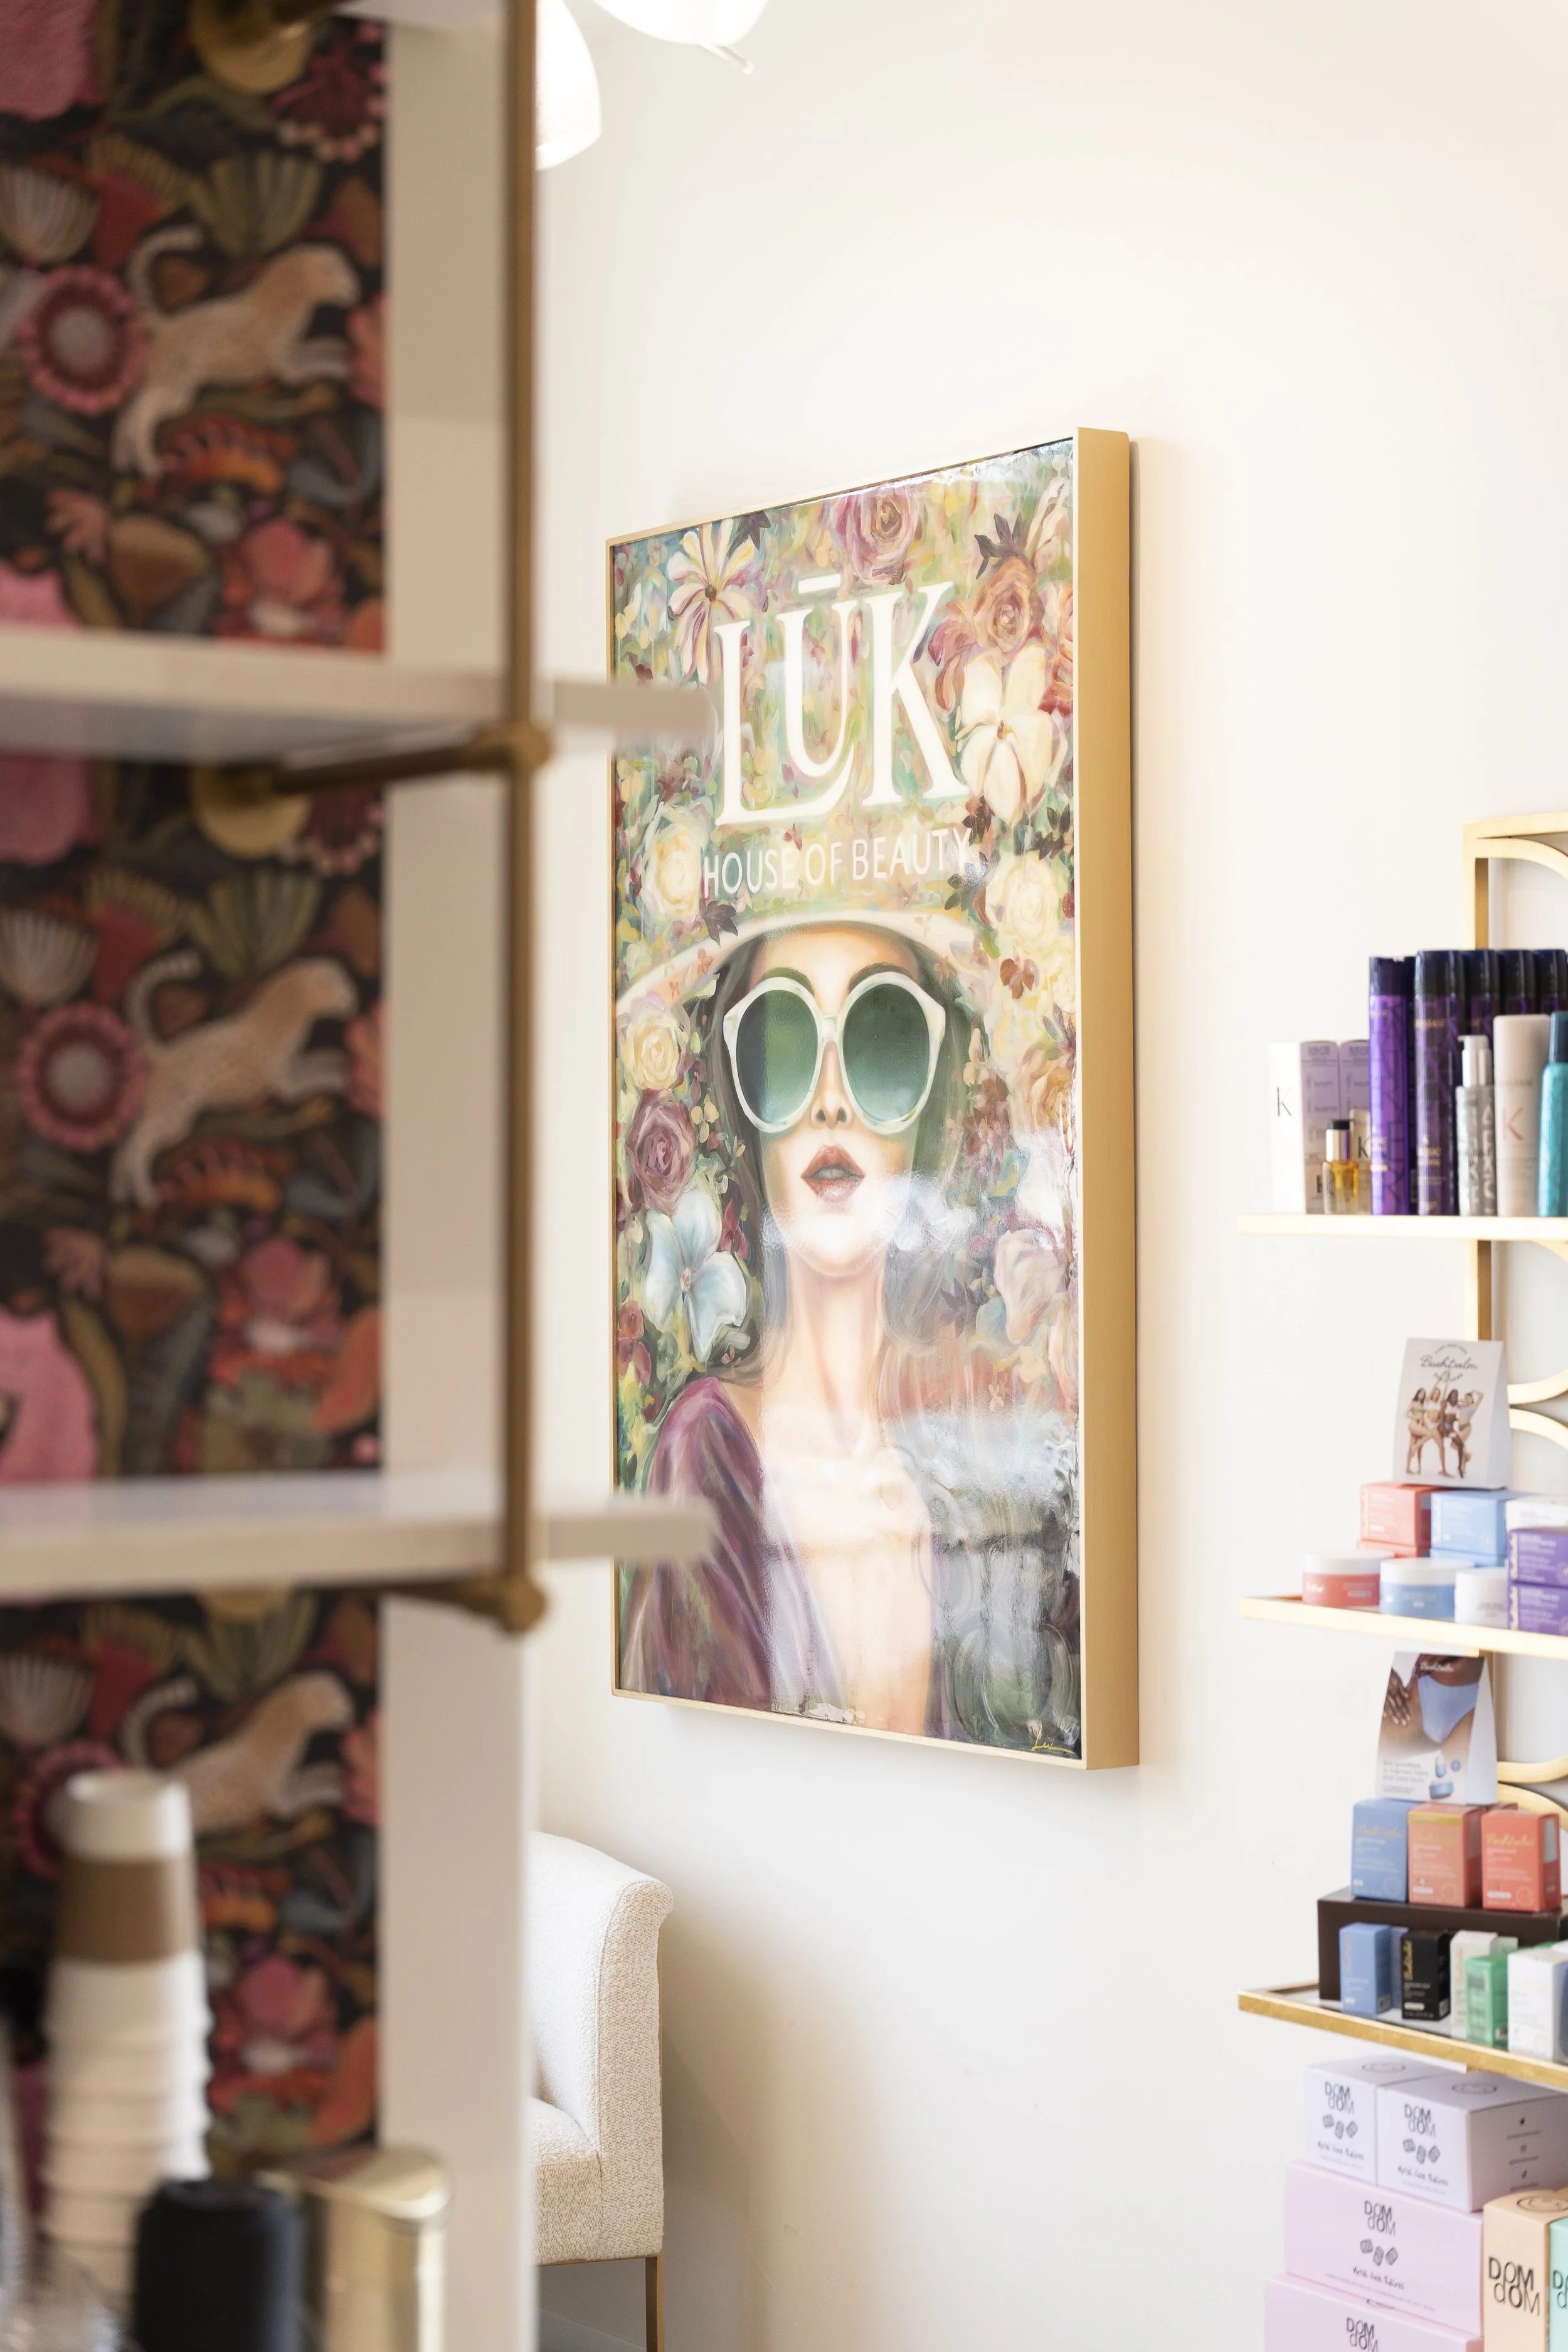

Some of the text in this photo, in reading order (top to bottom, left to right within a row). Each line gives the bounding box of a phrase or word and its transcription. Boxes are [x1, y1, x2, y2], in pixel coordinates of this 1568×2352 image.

[712, 573, 972, 826] LŪK
[703, 827, 972, 898] HOUSE OF BEAUTY
[1325, 2081, 1350, 2100] DOM
[1404, 2103, 1431, 2124] DOM
[1364, 2200, 1392, 2222] DOM
[1488, 2256, 1534, 2291] DOM
[1346, 2316, 1375, 2339] DOM
